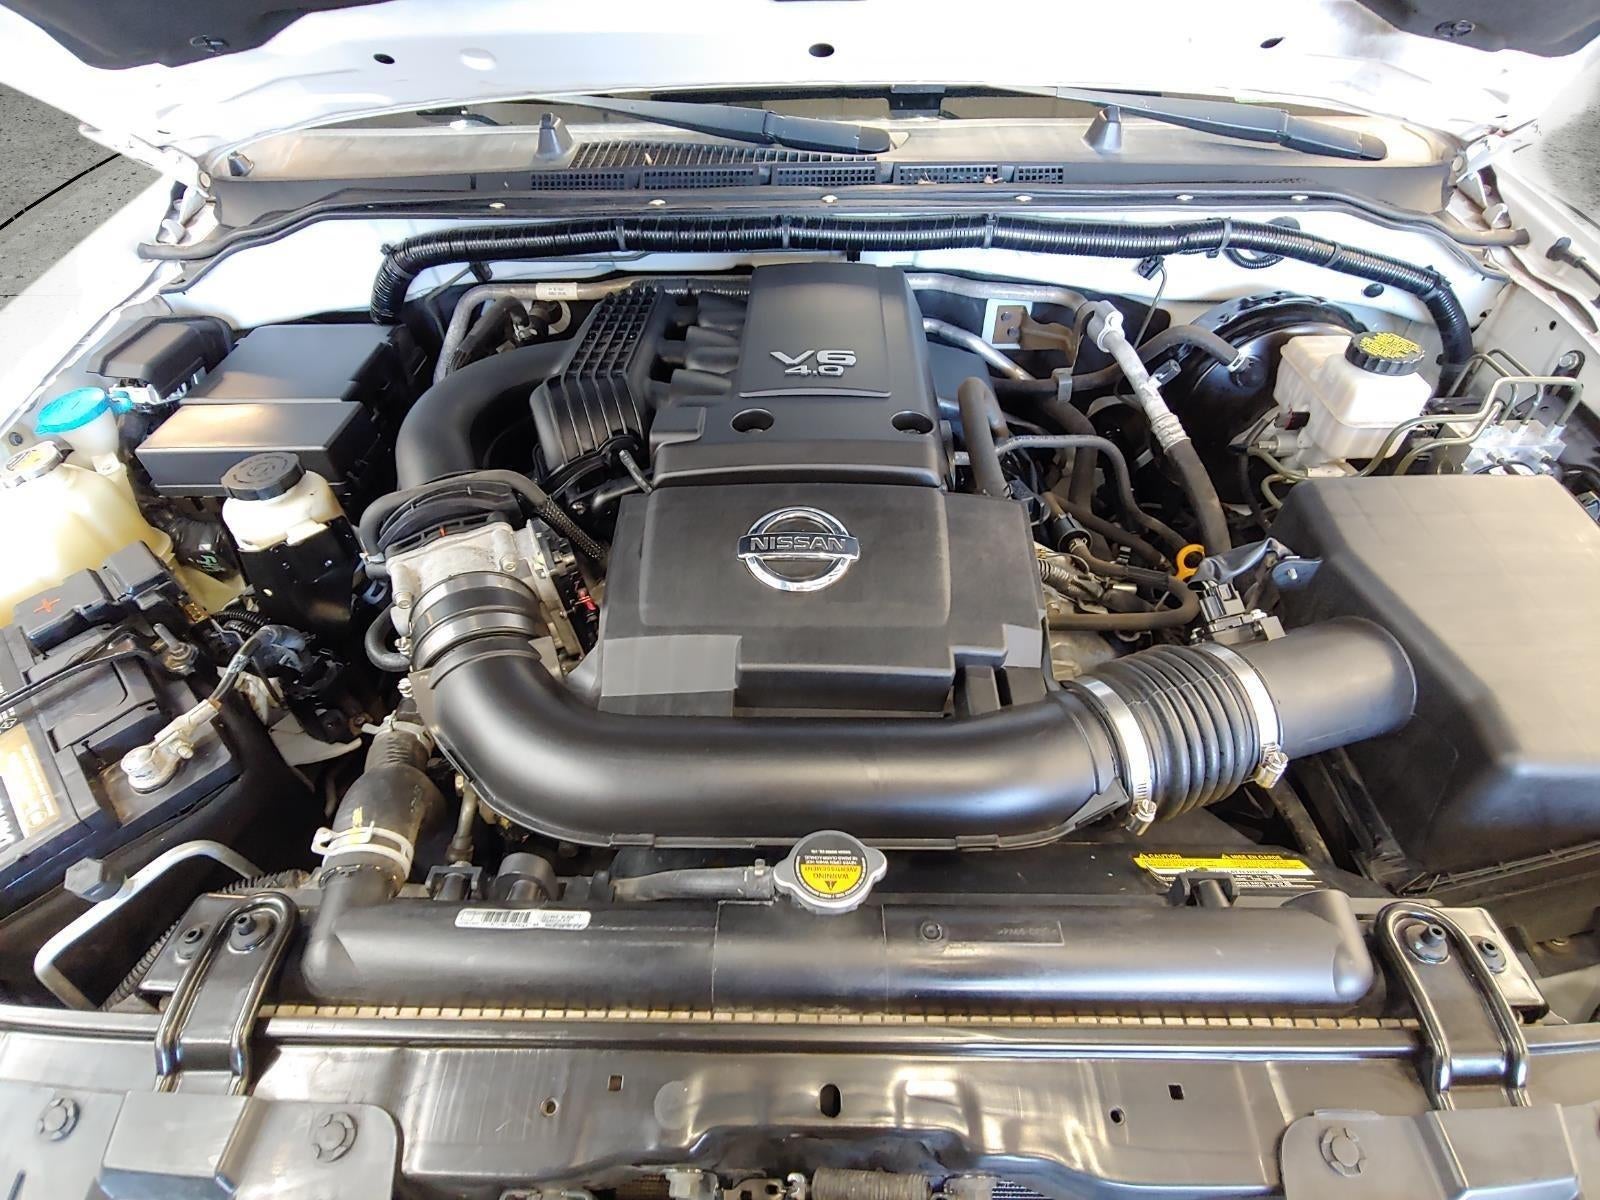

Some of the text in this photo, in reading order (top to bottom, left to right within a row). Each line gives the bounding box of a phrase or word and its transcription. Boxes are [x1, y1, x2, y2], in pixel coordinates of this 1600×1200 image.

[769, 350, 857, 366] V6
[784, 364, 845, 376] 4.0
[750, 536, 847, 551] NISSAN
